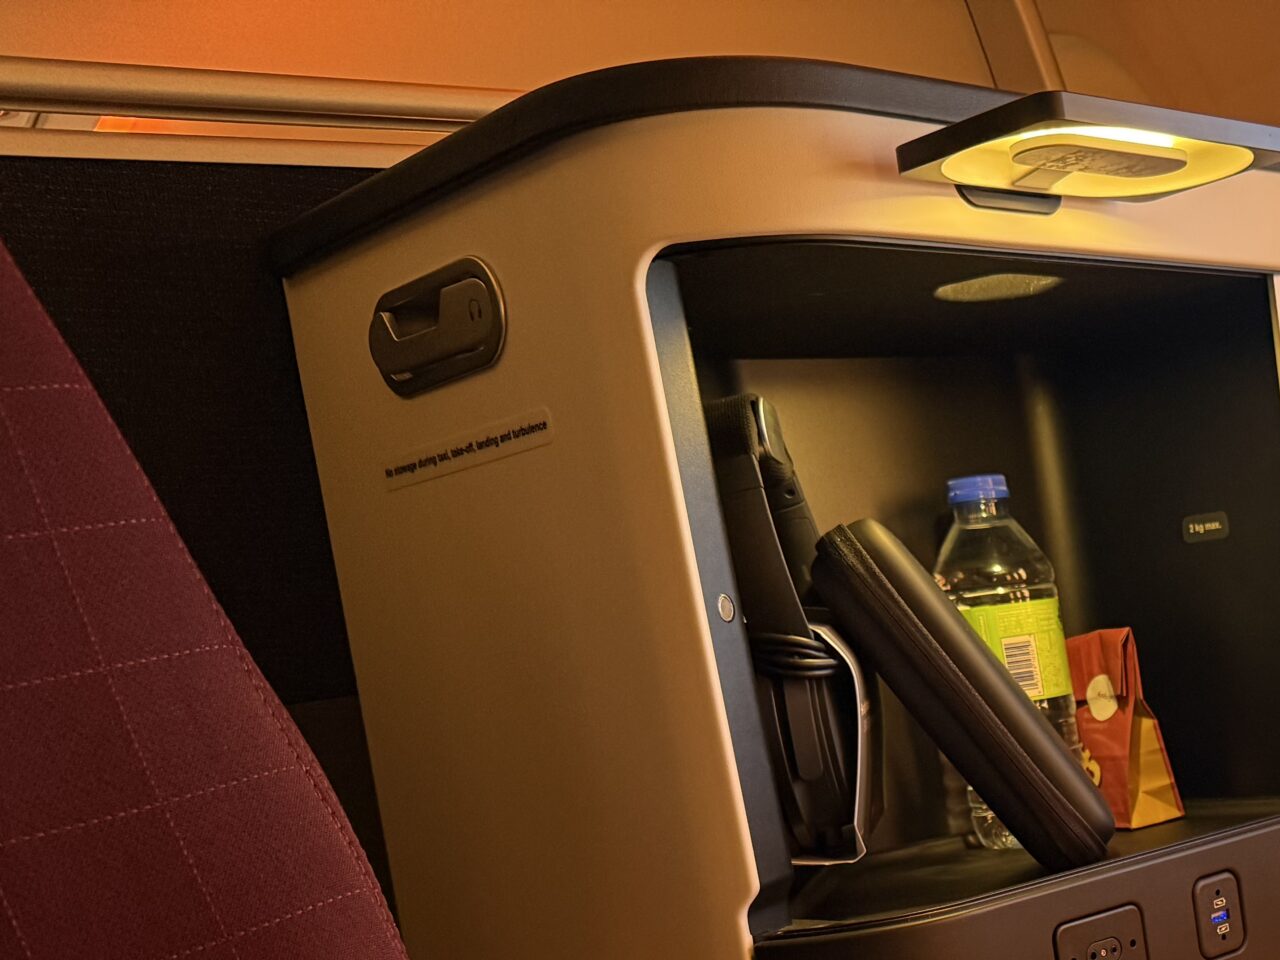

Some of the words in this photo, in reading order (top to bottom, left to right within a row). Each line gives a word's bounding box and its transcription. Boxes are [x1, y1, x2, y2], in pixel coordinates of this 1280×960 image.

[385, 468, 394, 479] No
[417, 456, 438, 469] during
[437, 449, 451, 462] taxi,
[475, 436, 499, 450] landing
[499, 430, 512, 443] and
[511, 421, 548, 439] turbulence
[1195, 523, 1204, 534] kg
[1205, 522, 1222, 531] max.
